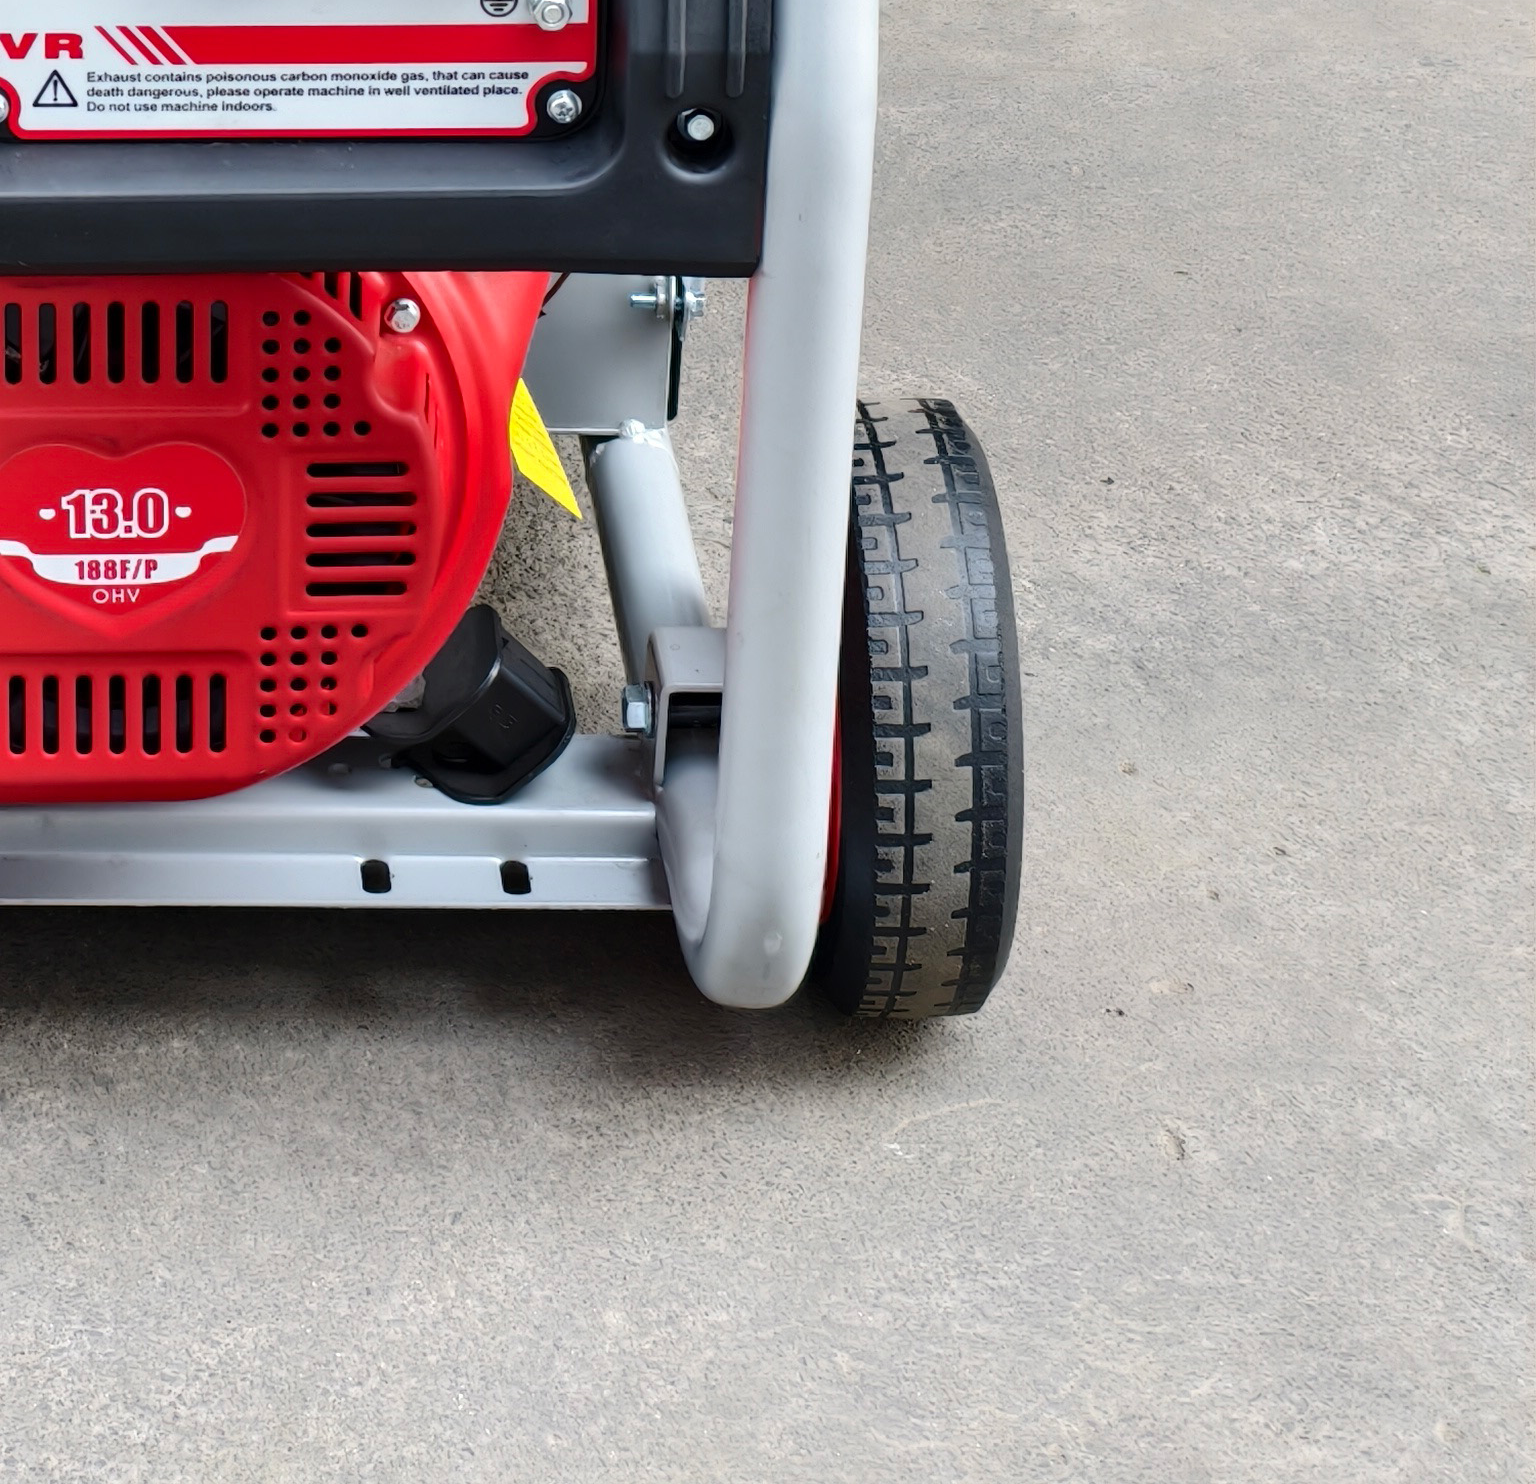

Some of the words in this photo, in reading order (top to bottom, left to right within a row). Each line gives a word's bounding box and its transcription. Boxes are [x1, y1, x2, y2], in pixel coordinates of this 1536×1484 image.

[86, 72, 142, 83] Exhaust
[144, 71, 203, 83] contains
[206, 71, 277, 84] poisonous
[280, 71, 327, 82] carbon
[330, 70, 398, 82] monoxide
[400, 72, 429, 84] gas,
[432, 70, 458, 81] that
[461, 71, 486, 81] can
[488, 71, 529, 81] cause
[86, 86, 124, 97] death
[128, 86, 203, 99] dangerous,
[206, 86, 250, 99] please
[253, 86, 304, 98] operate
[307, 85, 364, 96] machine
[368, 85, 380, 96] in
[384, 84, 411, 96] well
[414, 84, 479, 96] ventilated
[482, 84, 523, 98] place.
[86, 101, 105, 112] Do
[109, 102, 131, 112] not
[134, 104, 158, 112] use
[161, 100, 218, 112] machine
[221, 100, 277, 112] indoors.
[61, 487, 170, 539] 13.0
[75, 559, 158, 580] 188F/P
[92, 588, 140, 604] OHV
